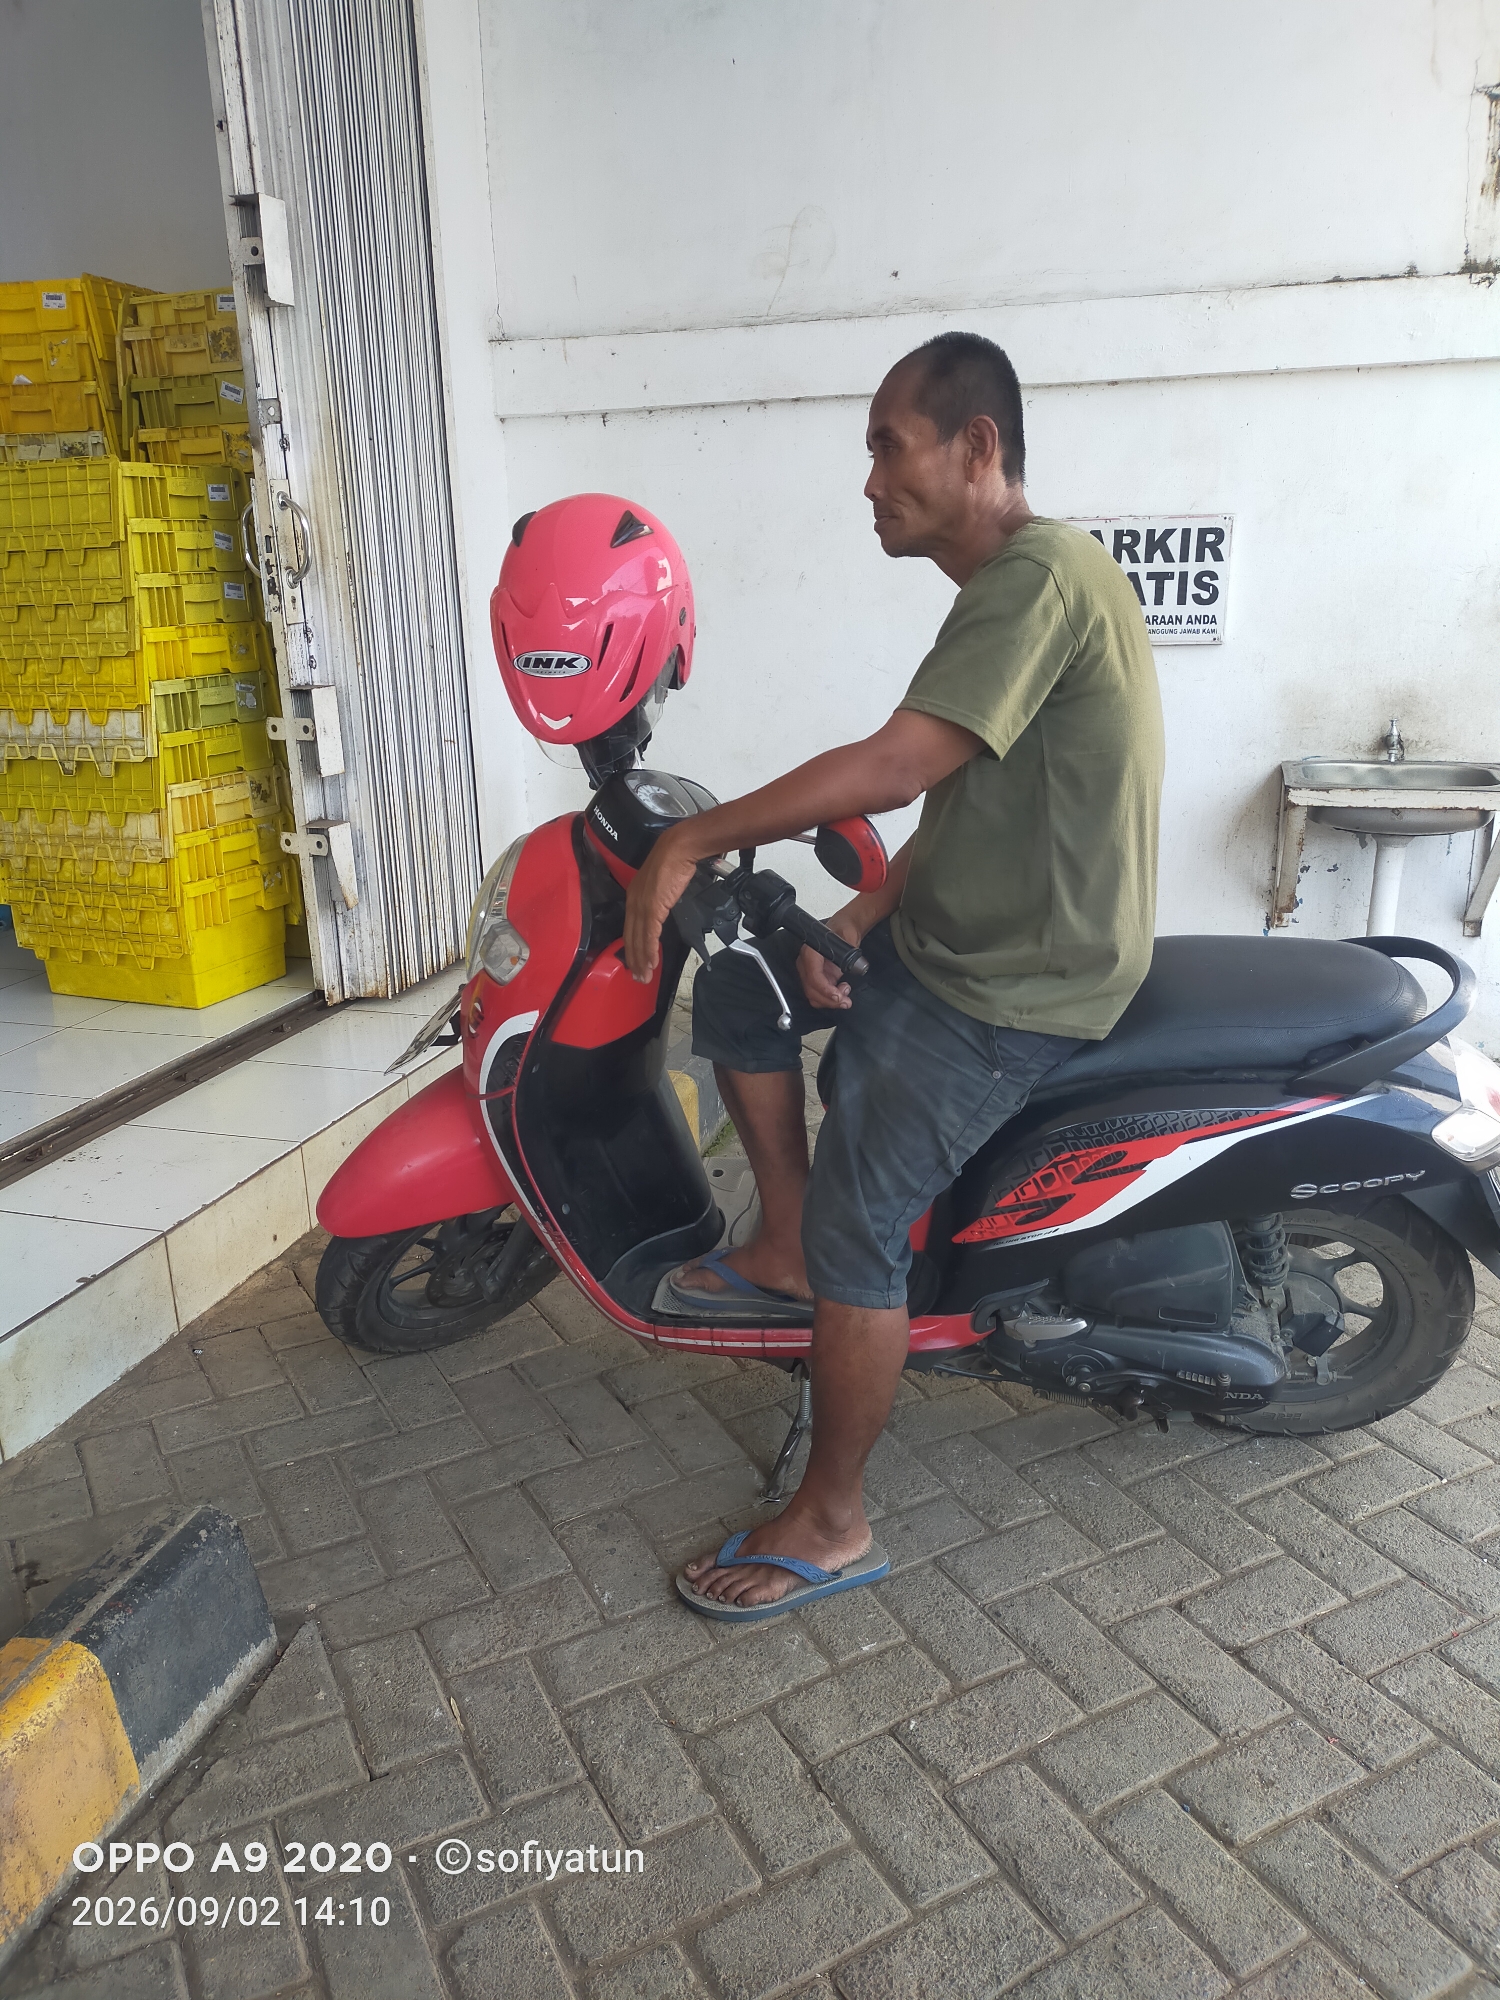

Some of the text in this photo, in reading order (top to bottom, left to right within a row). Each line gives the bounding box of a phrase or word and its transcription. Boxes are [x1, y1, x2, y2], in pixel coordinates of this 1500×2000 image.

[1186, 615, 1218, 625] ANDA
[523, 657, 580, 668] INK
[593, 804, 618, 841] HONDA
